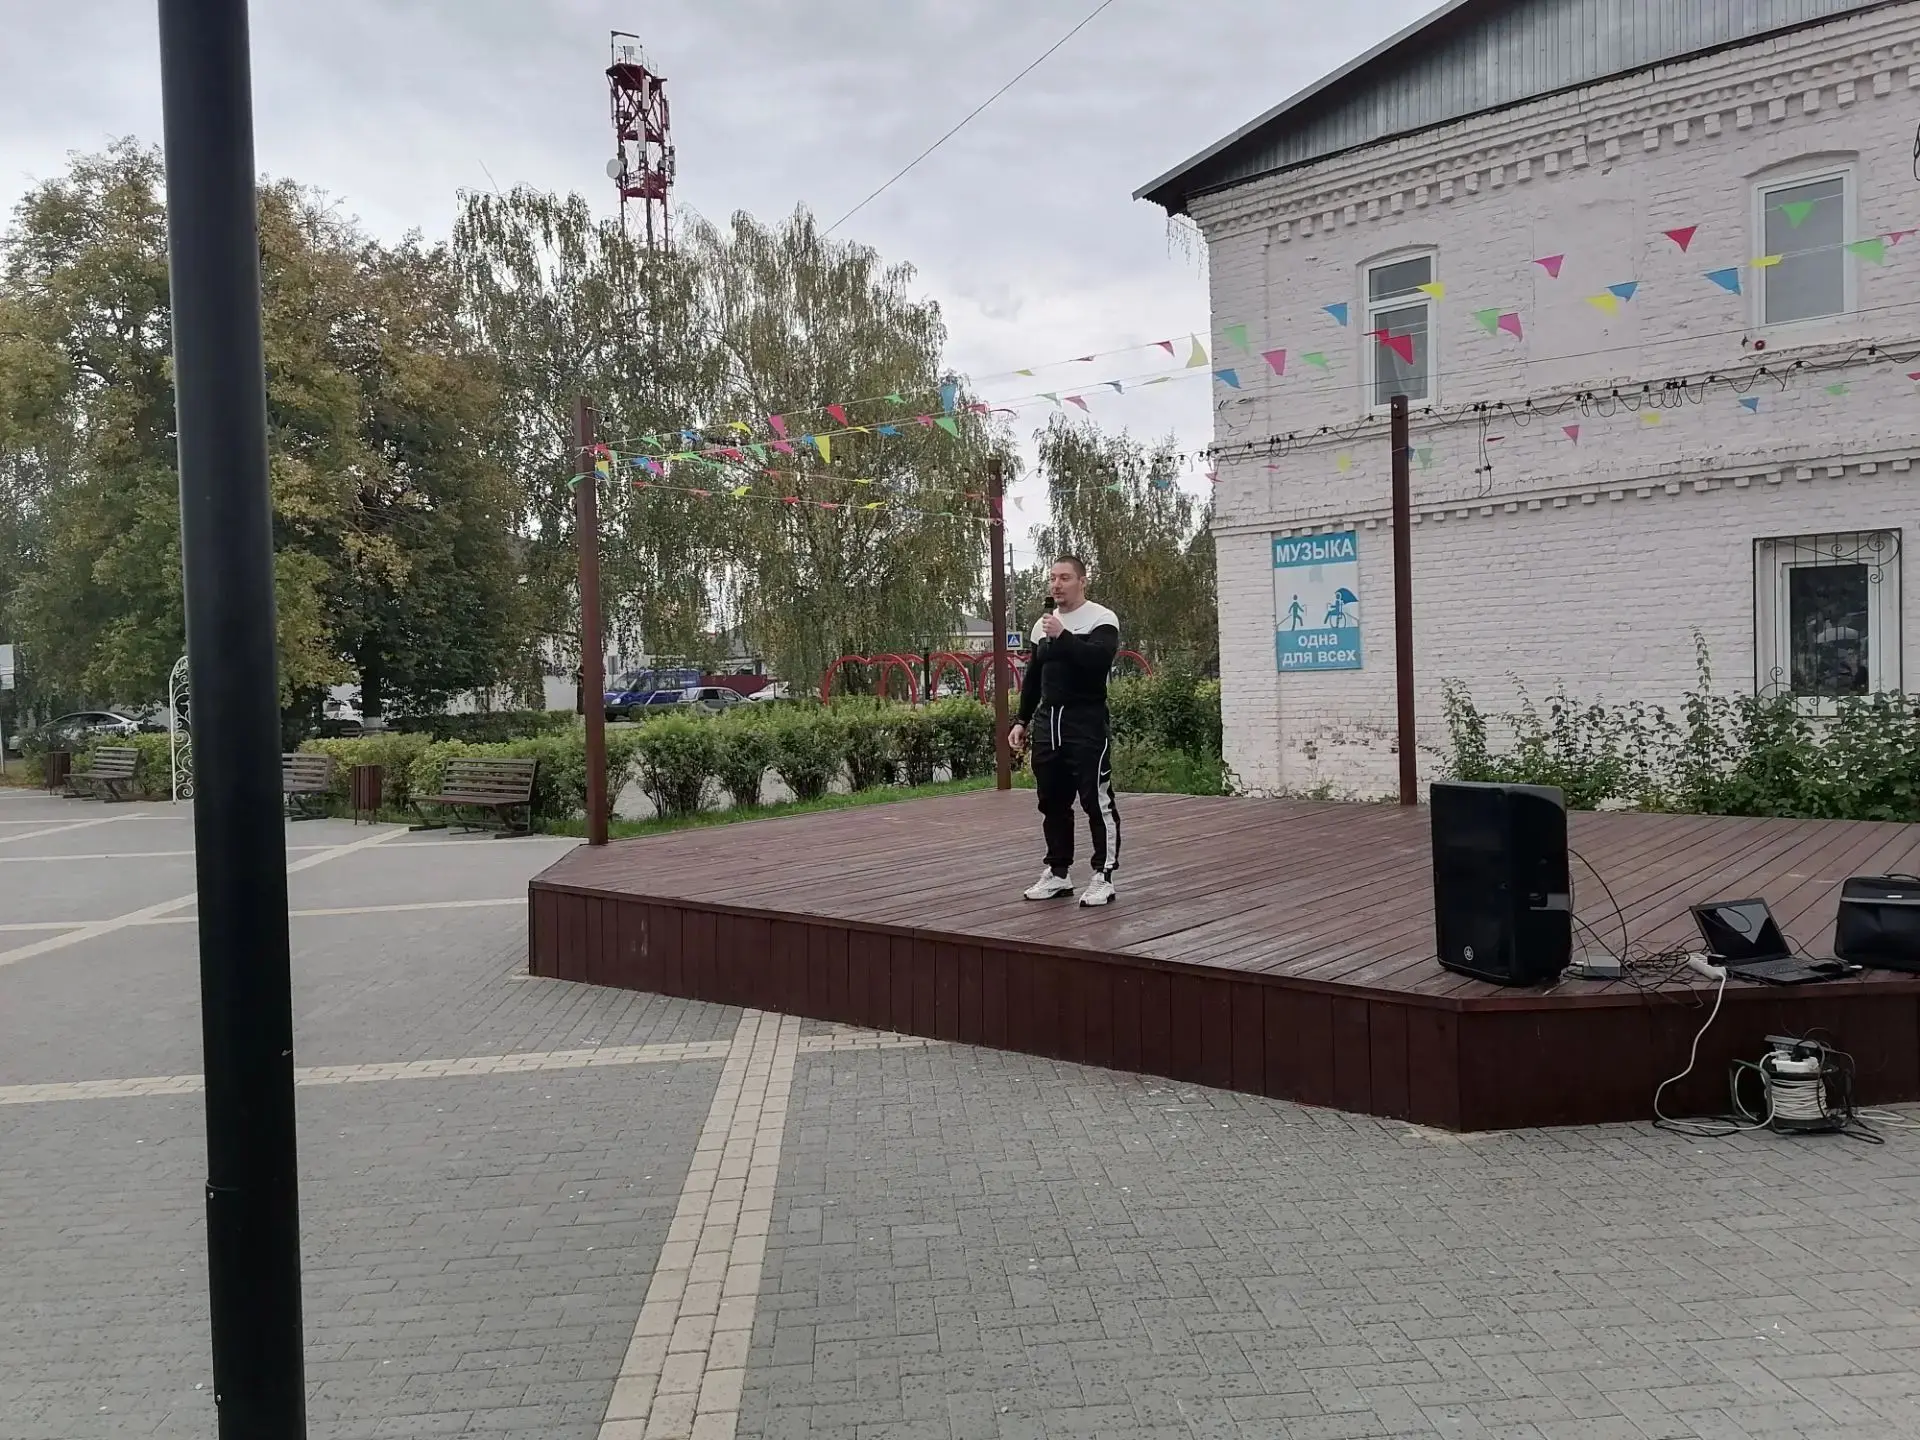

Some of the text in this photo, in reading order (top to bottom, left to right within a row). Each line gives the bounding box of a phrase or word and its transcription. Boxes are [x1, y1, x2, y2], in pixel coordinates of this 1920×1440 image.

[1276, 539, 1354, 563] МУЗЫКА
[1298, 633, 1338, 648] одна
[1282, 649, 1356, 666] для всех
